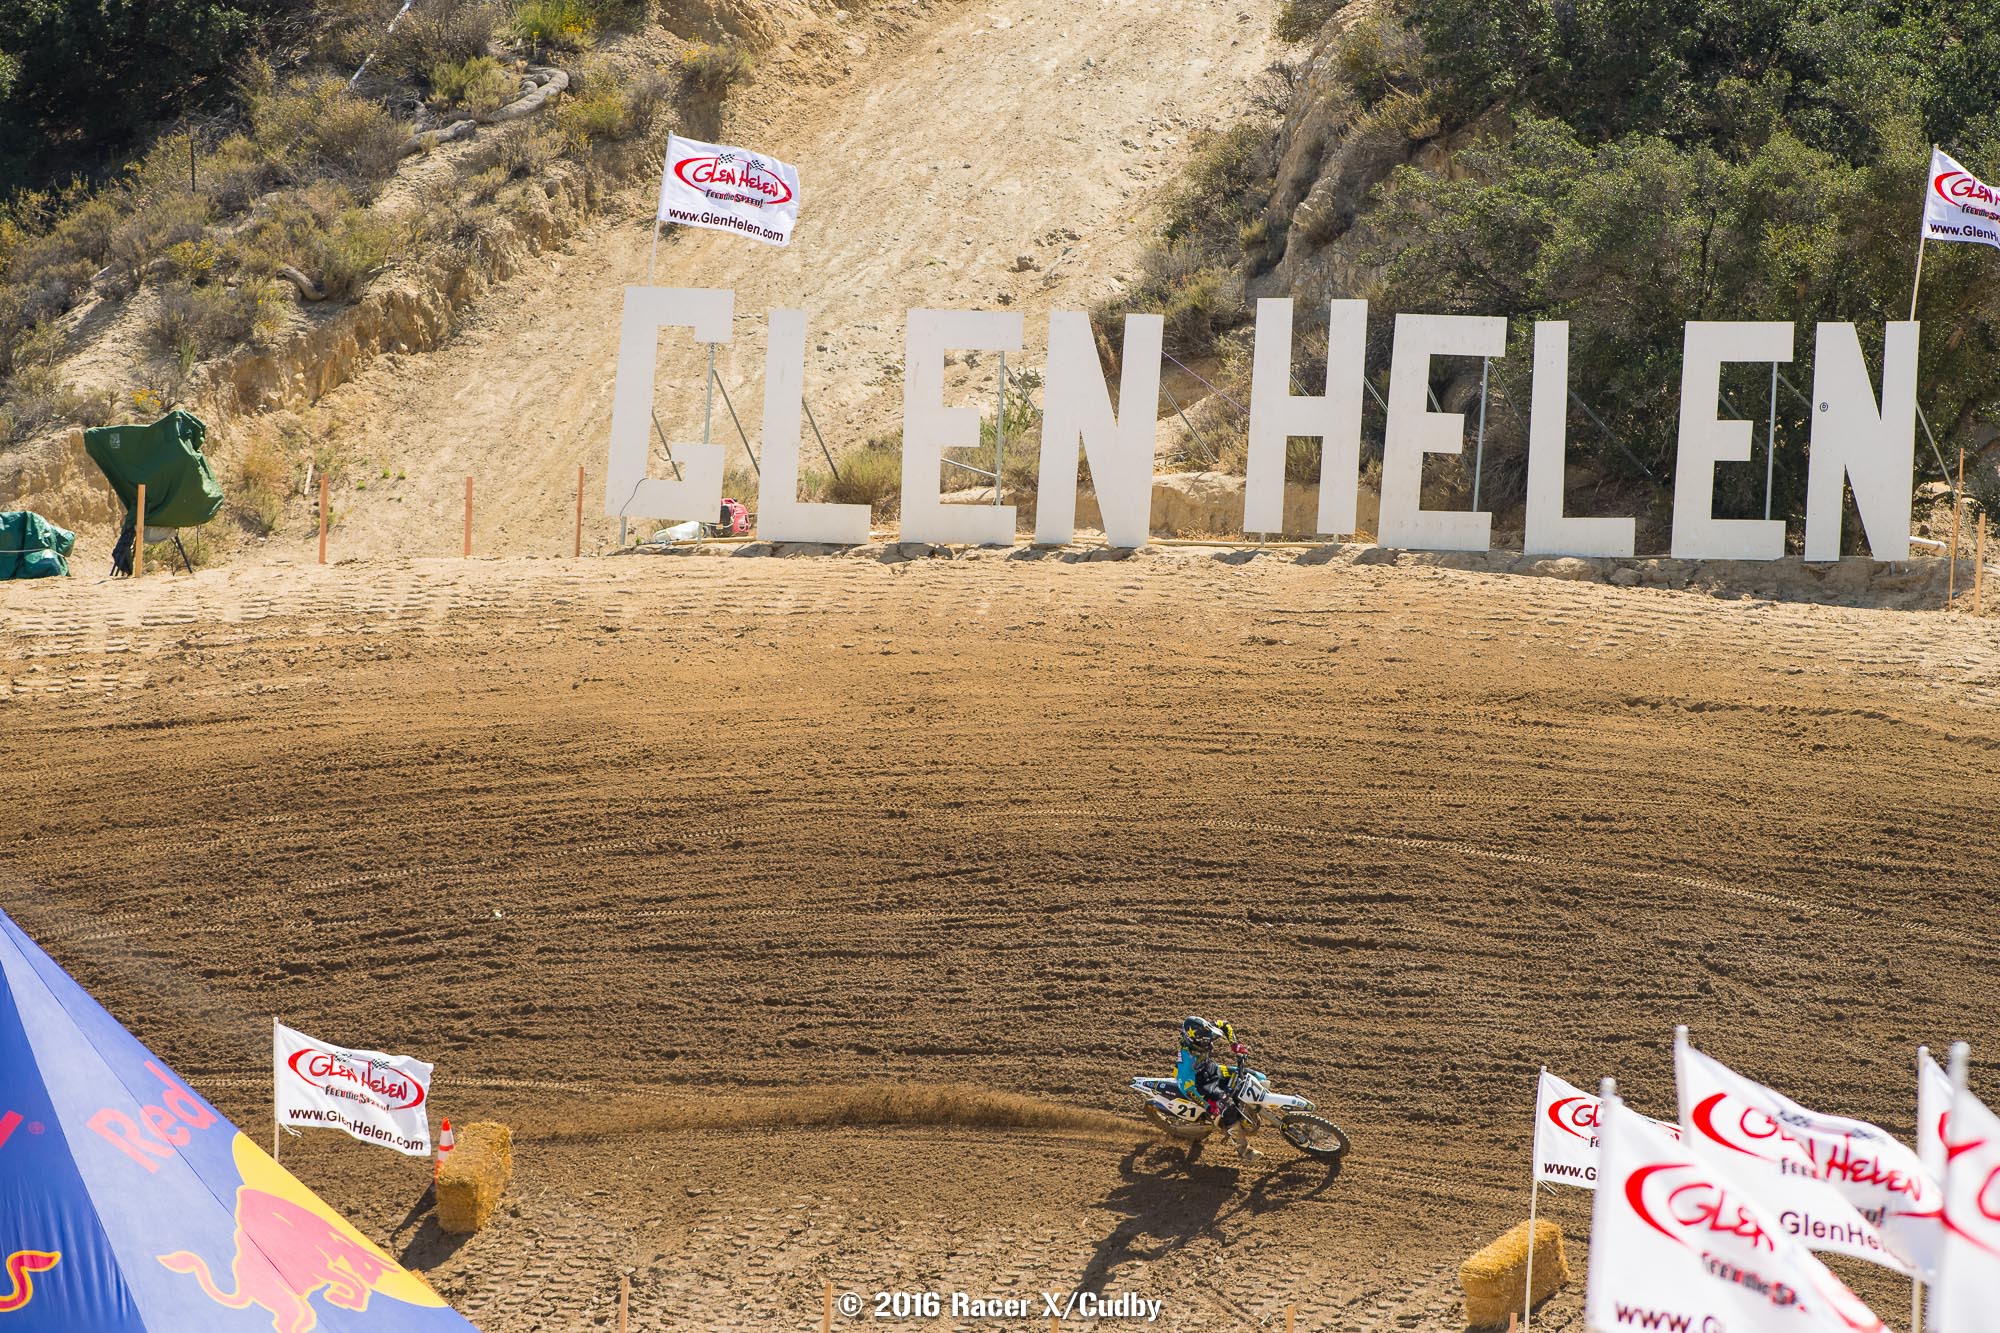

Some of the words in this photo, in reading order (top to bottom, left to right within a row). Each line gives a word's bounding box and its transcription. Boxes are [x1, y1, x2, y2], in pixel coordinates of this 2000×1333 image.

[668, 208, 784, 242] www.GlenHelen.com
[605, 286, 1164, 548] GLEN
[1243, 298, 1921, 562] HELEN
[86, 1060, 218, 1174] Red
[289, 1108, 424, 1151] www.GlenHelen.com
[1177, 1104, 1197, 1118] 21
[1544, 1162, 1600, 1181] www.G
